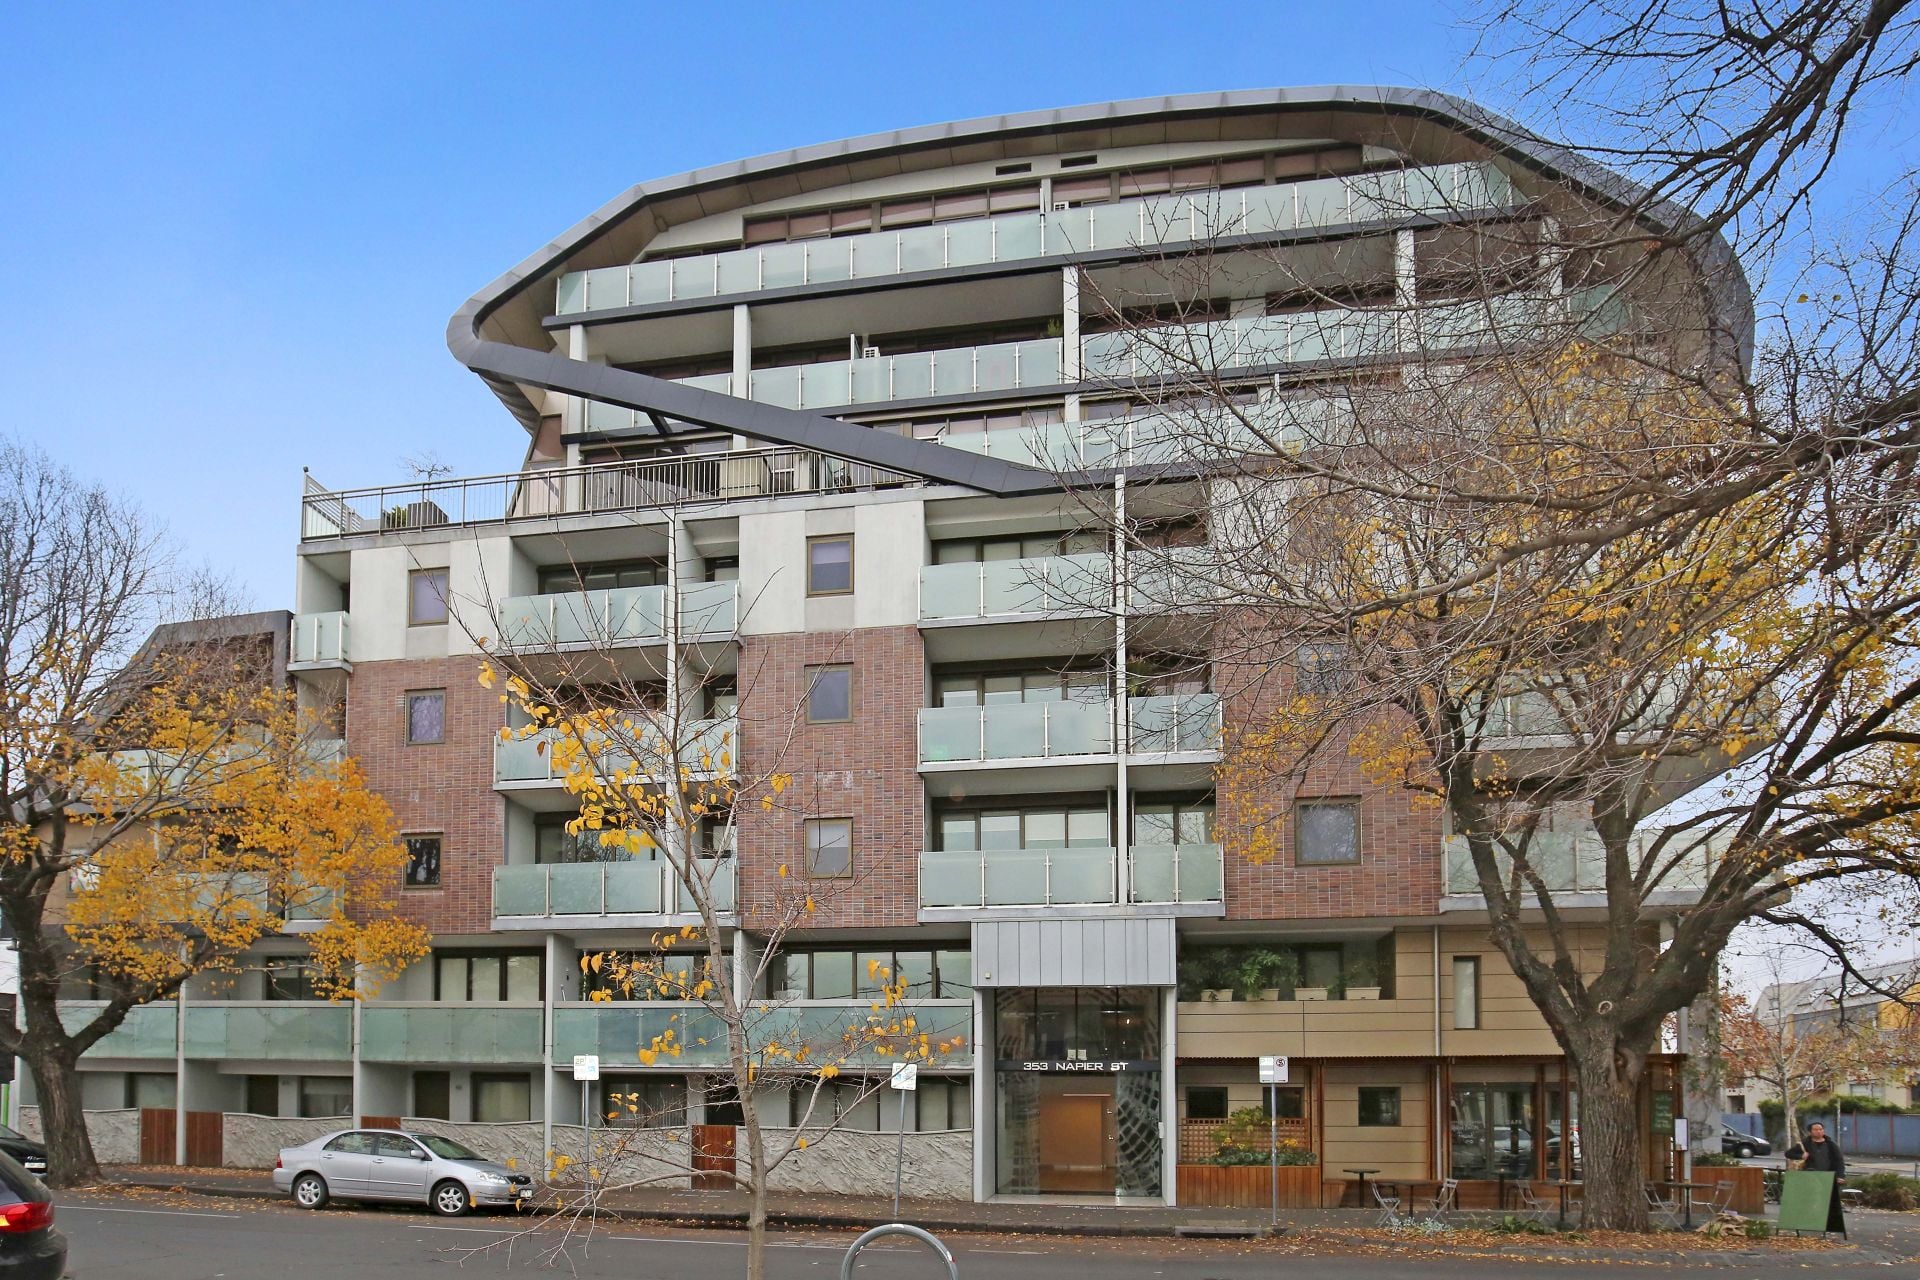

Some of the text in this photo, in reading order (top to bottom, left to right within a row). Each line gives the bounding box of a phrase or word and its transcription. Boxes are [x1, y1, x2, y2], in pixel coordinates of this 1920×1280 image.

[1023, 1062, 1128, 1071] 353 NAPIER ST
